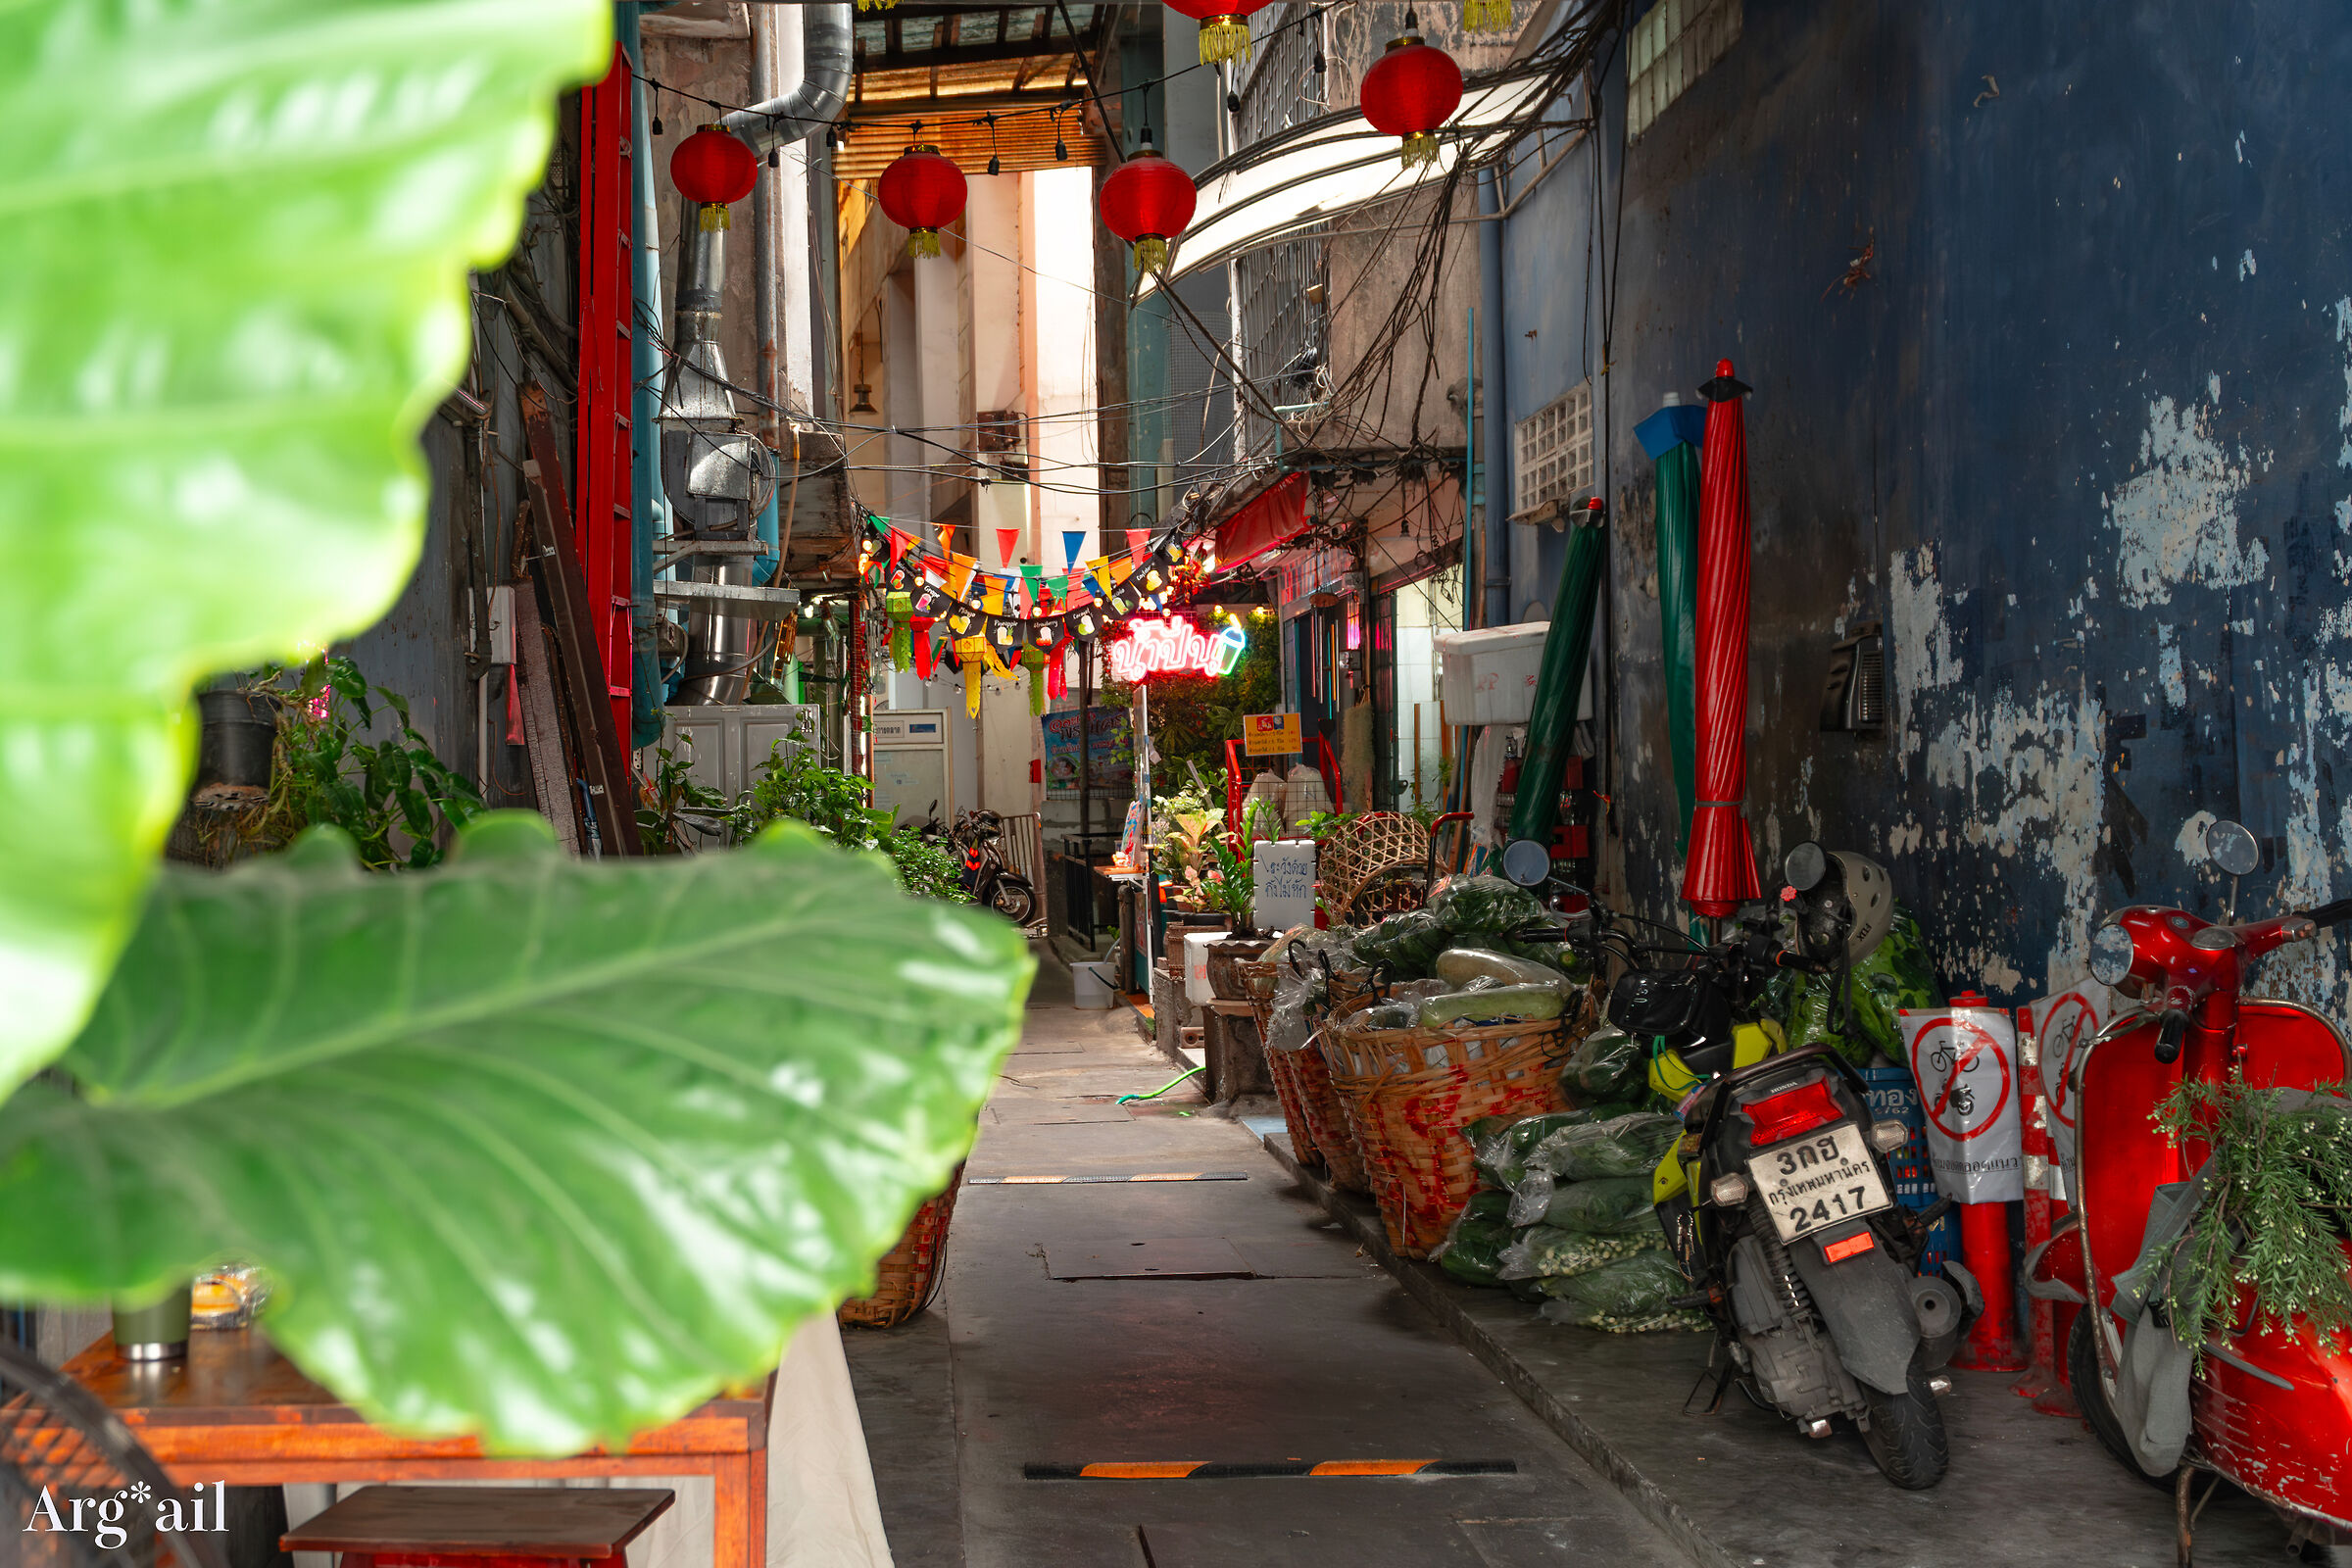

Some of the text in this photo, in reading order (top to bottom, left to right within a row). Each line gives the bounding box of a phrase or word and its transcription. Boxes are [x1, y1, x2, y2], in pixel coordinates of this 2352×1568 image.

[923, 585, 941, 599] Grape
[957, 607, 976, 618] Mango
[1770, 1081, 1798, 1094] HONDA
[1776, 1135, 1840, 1176] 3กฮ
[1768, 1160, 1871, 1205] กรุงเทพมหานคร
[1789, 1186, 1866, 1233] 2417
